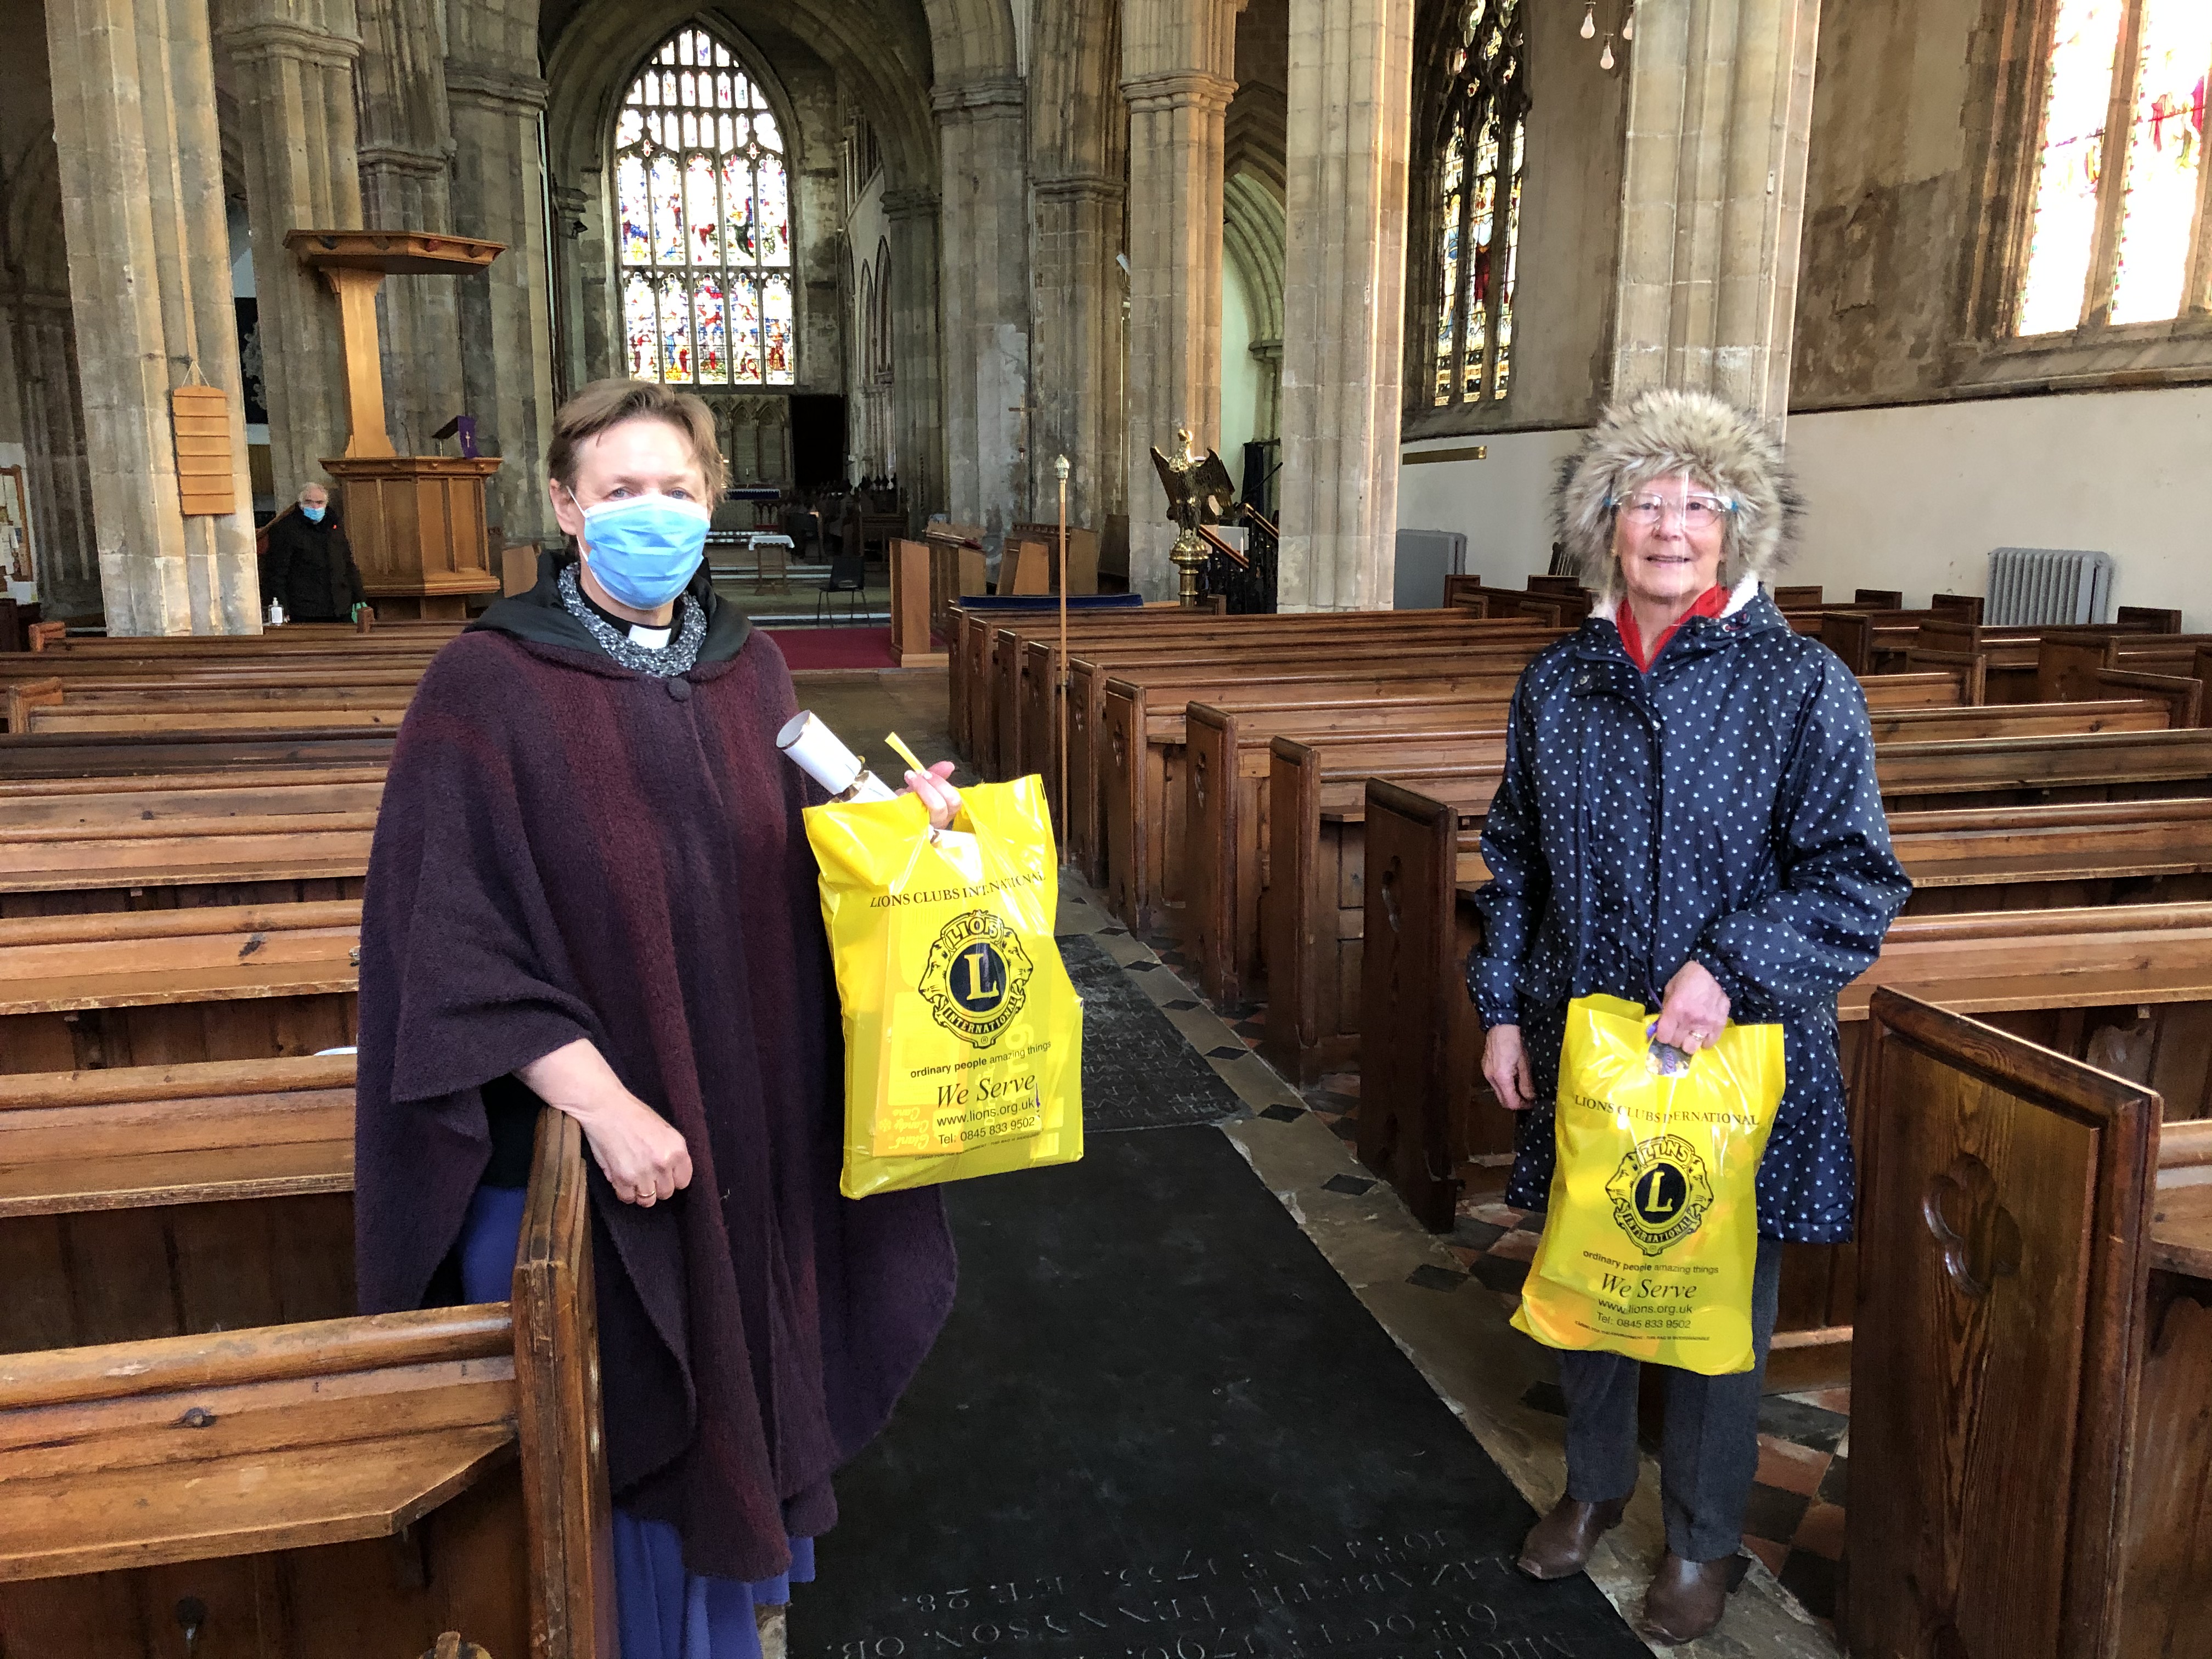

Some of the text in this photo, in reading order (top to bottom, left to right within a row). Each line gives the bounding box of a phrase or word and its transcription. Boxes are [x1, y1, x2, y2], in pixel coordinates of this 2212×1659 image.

[870, 872, 1046, 907] LIONS CLUBS INTNATIONAL
[964, 953, 999, 1001] L
[944, 996, 1018, 1034] INTERNATIONAL
[911, 1041, 1051, 1078] ordinary people amazing things
[938, 1075, 1035, 1108] We Serve
[937, 1097, 1035, 1127] www.lions.org.uk
[1575, 1094, 1759, 1125] LIONS CLUBS IERNATIONAL
[894, 1118, 929, 1133] Candy
[939, 1116, 1035, 1146] Tel: 0845 833 9502
[1645, 1171, 1673, 1212] L
[1583, 1250, 1719, 1274] ordinary people amazing things
[1601, 1273, 1697, 1299] We Serve
[1597, 1312, 1691, 1329] Tel: 0845 833 9502
[1598, 1299, 1692, 1316] www.lions.org.uk
